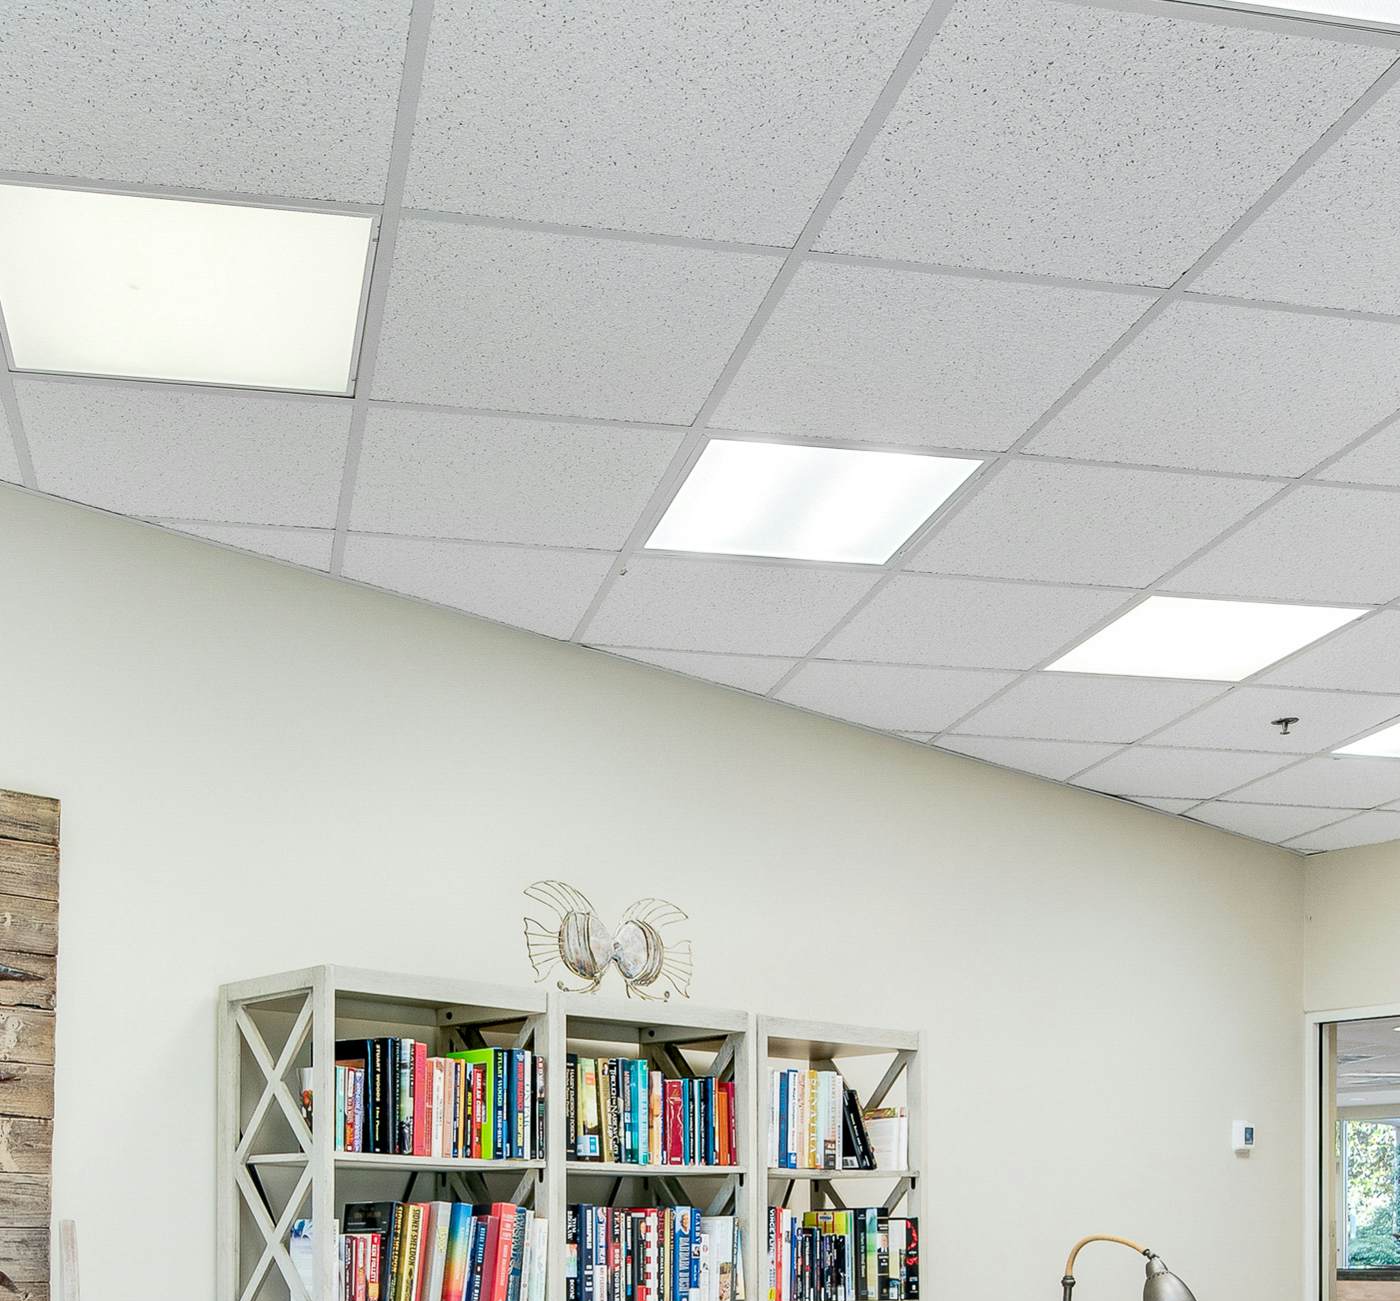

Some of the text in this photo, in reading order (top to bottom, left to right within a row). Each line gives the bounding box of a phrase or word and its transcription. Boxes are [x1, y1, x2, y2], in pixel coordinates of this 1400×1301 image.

[809, 1077, 817, 1153] SINATRA
[394, 1206, 403, 1233] SIDNEY
[408, 1208, 420, 1266] SIDNEY SHELDON
[391, 1236, 400, 1273] SHELDON
[679, 1237, 690, 1292] BARBARA BUSH
